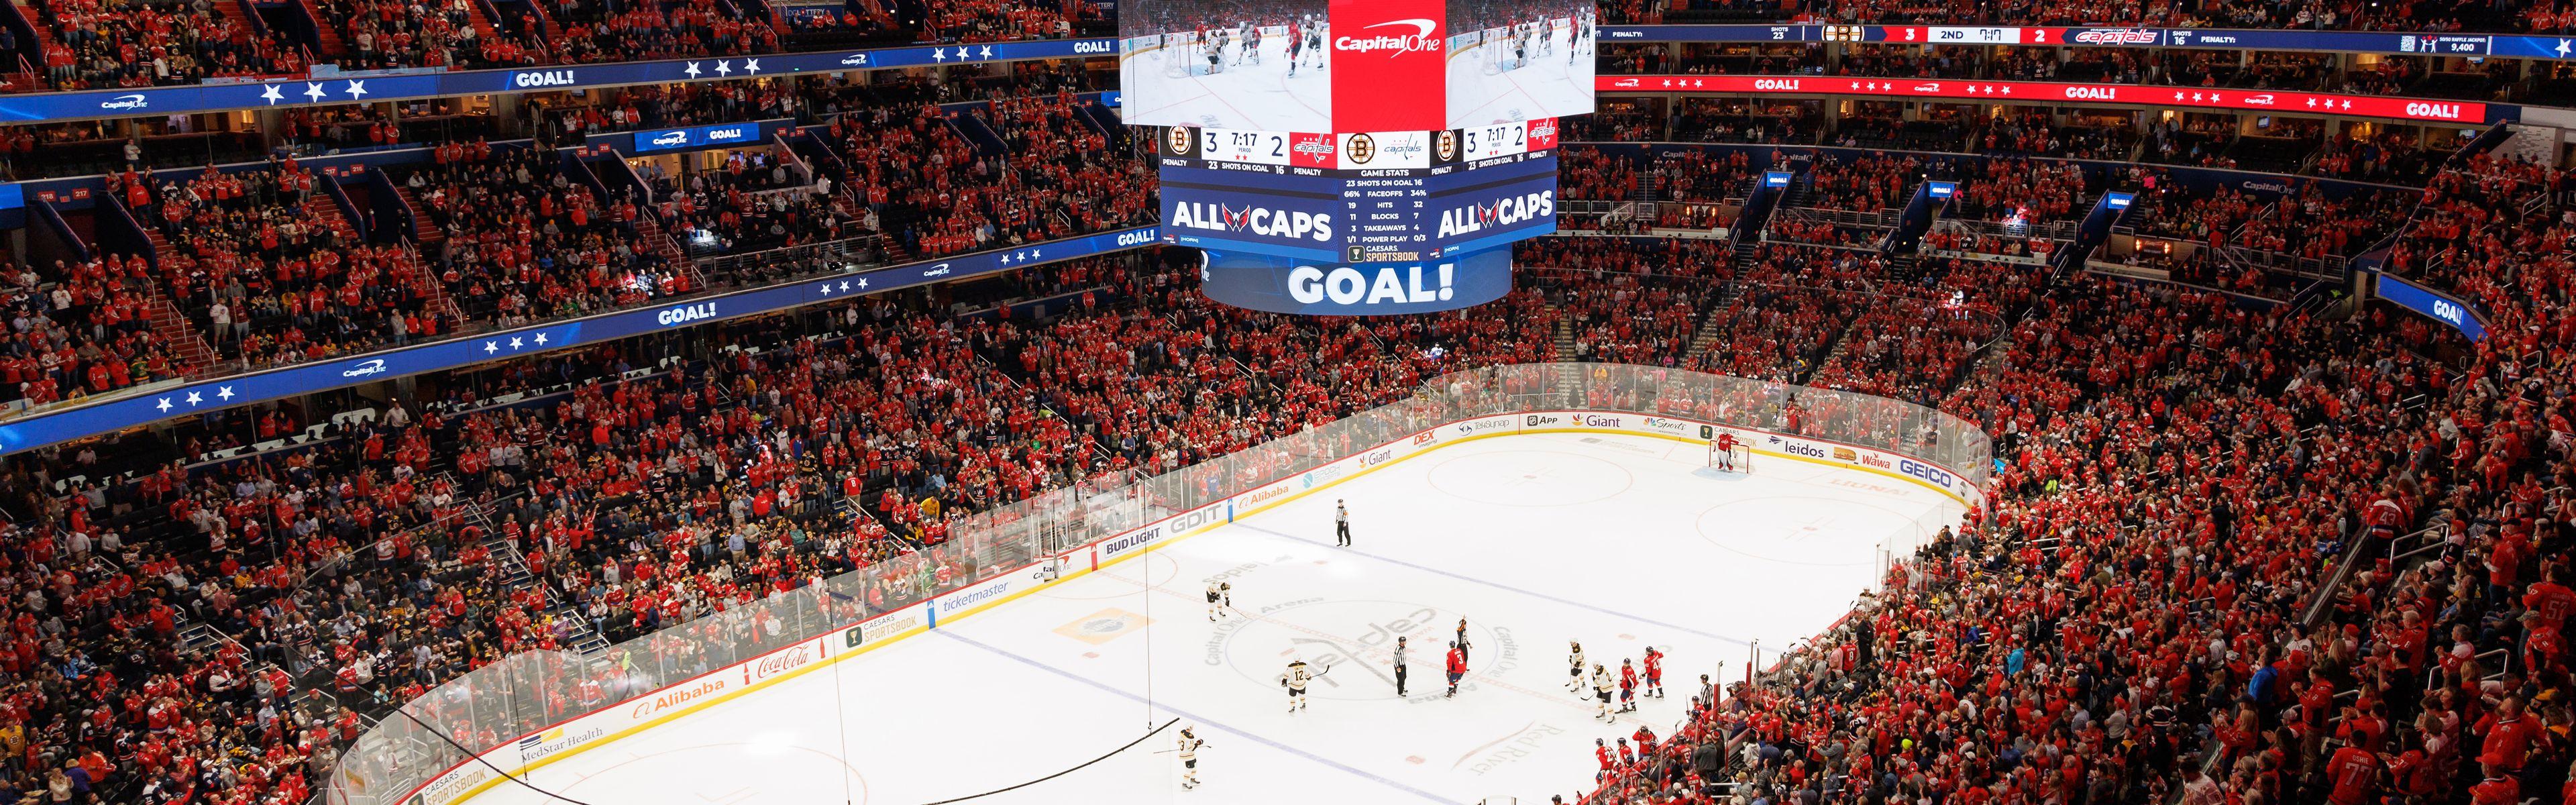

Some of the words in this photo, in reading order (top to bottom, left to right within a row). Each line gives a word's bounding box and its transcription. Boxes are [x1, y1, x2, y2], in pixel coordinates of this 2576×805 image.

[1905, 29, 1915, 40] 3
[1941, 31, 1964, 39] 2ND
[1980, 30, 2001, 40] 7:17
[2035, 30, 2045, 42] 2
[2175, 36, 2185, 44] 16
[1074, 41, 1110, 53] GOAL!
[2451, 44, 2474, 52] 9,400
[517, 70, 575, 87] GOAL!
[1755, 80, 1799, 90] GOAL!
[2066, 87, 2115, 99] GOAL!
[2407, 103, 2459, 118] GOAL!
[710, 129, 741, 140] GOAL!
[1206, 132, 1217, 152] 3
[1232, 132, 1256, 146] 7:17
[1468, 133, 1476, 152] 3
[1487, 127, 1505, 142] 7:17
[1515, 126, 1523, 146] 2
[1272, 136, 1283, 156] 2
[1468, 161, 1476, 170] 23
[1479, 158, 1493, 168] SHOTS
[1501, 156, 1513, 164] GOAL
[1517, 154, 1523, 162] 16
[1529, 151, 1547, 159] PENALTY
[1208, 161, 1218, 169] 23
[1222, 162, 1241, 170] SHOTS
[1275, 166, 1284, 174] 16
[1294, 168, 1322, 176] PENALTY
[1432, 166, 1452, 175] PENALTY
[1172, 201, 1226, 231] ALL
[1250, 207, 1332, 241] CAPS
[1438, 205, 1480, 238] ALL
[1499, 190, 1552, 225] CAPS
[1118, 229, 1155, 246] GOAL!
[1366, 252, 1419, 262] SPORTSBOOK
[1287, 263, 1454, 304] GOAL!
[659, 303, 716, 325] GOAL!
[2434, 300, 2462, 325] GOAL!
[1474, 420, 1509, 429] TekSynap
[1587, 415, 1620, 428] Giant
[1657, 419, 1686, 431] Sports
[1413, 430, 1435, 445] DEX
[1419, 439, 1437, 448] imaging
[1368, 448, 1391, 466] Giant
[1784, 440, 1824, 458] leidos
[1862, 454, 1891, 470] Wawa
[1900, 460, 1951, 488] GEICO
[1250, 484, 1289, 505] Alibaba
[1170, 504, 1221, 534] GDIT
[2379, 512, 2396, 526] 43
[1107, 537, 1129, 555] BUD
[1130, 527, 1161, 546] LIGHT
[944, 582, 1008, 612] ticketmaster
[1260, 596, 1325, 614] Arena
[863, 614, 895, 631] CAESARS
[864, 615, 917, 643] SPORTSBOOK
[1204, 631, 1223, 667] Capital
[1457, 654, 1464, 664] 3
[1295, 671, 1303, 681] 12
[655, 679, 724, 711] Alibaba
[522, 743, 566, 764] MedStar
[568, 727, 603, 746] Health
[2353, 755, 2369, 764] OSHIE
[425, 771, 460, 796] CAESARS
[2345, 763, 2373, 790] 77
[427, 767, 486, 805] SPORTSBOOK
